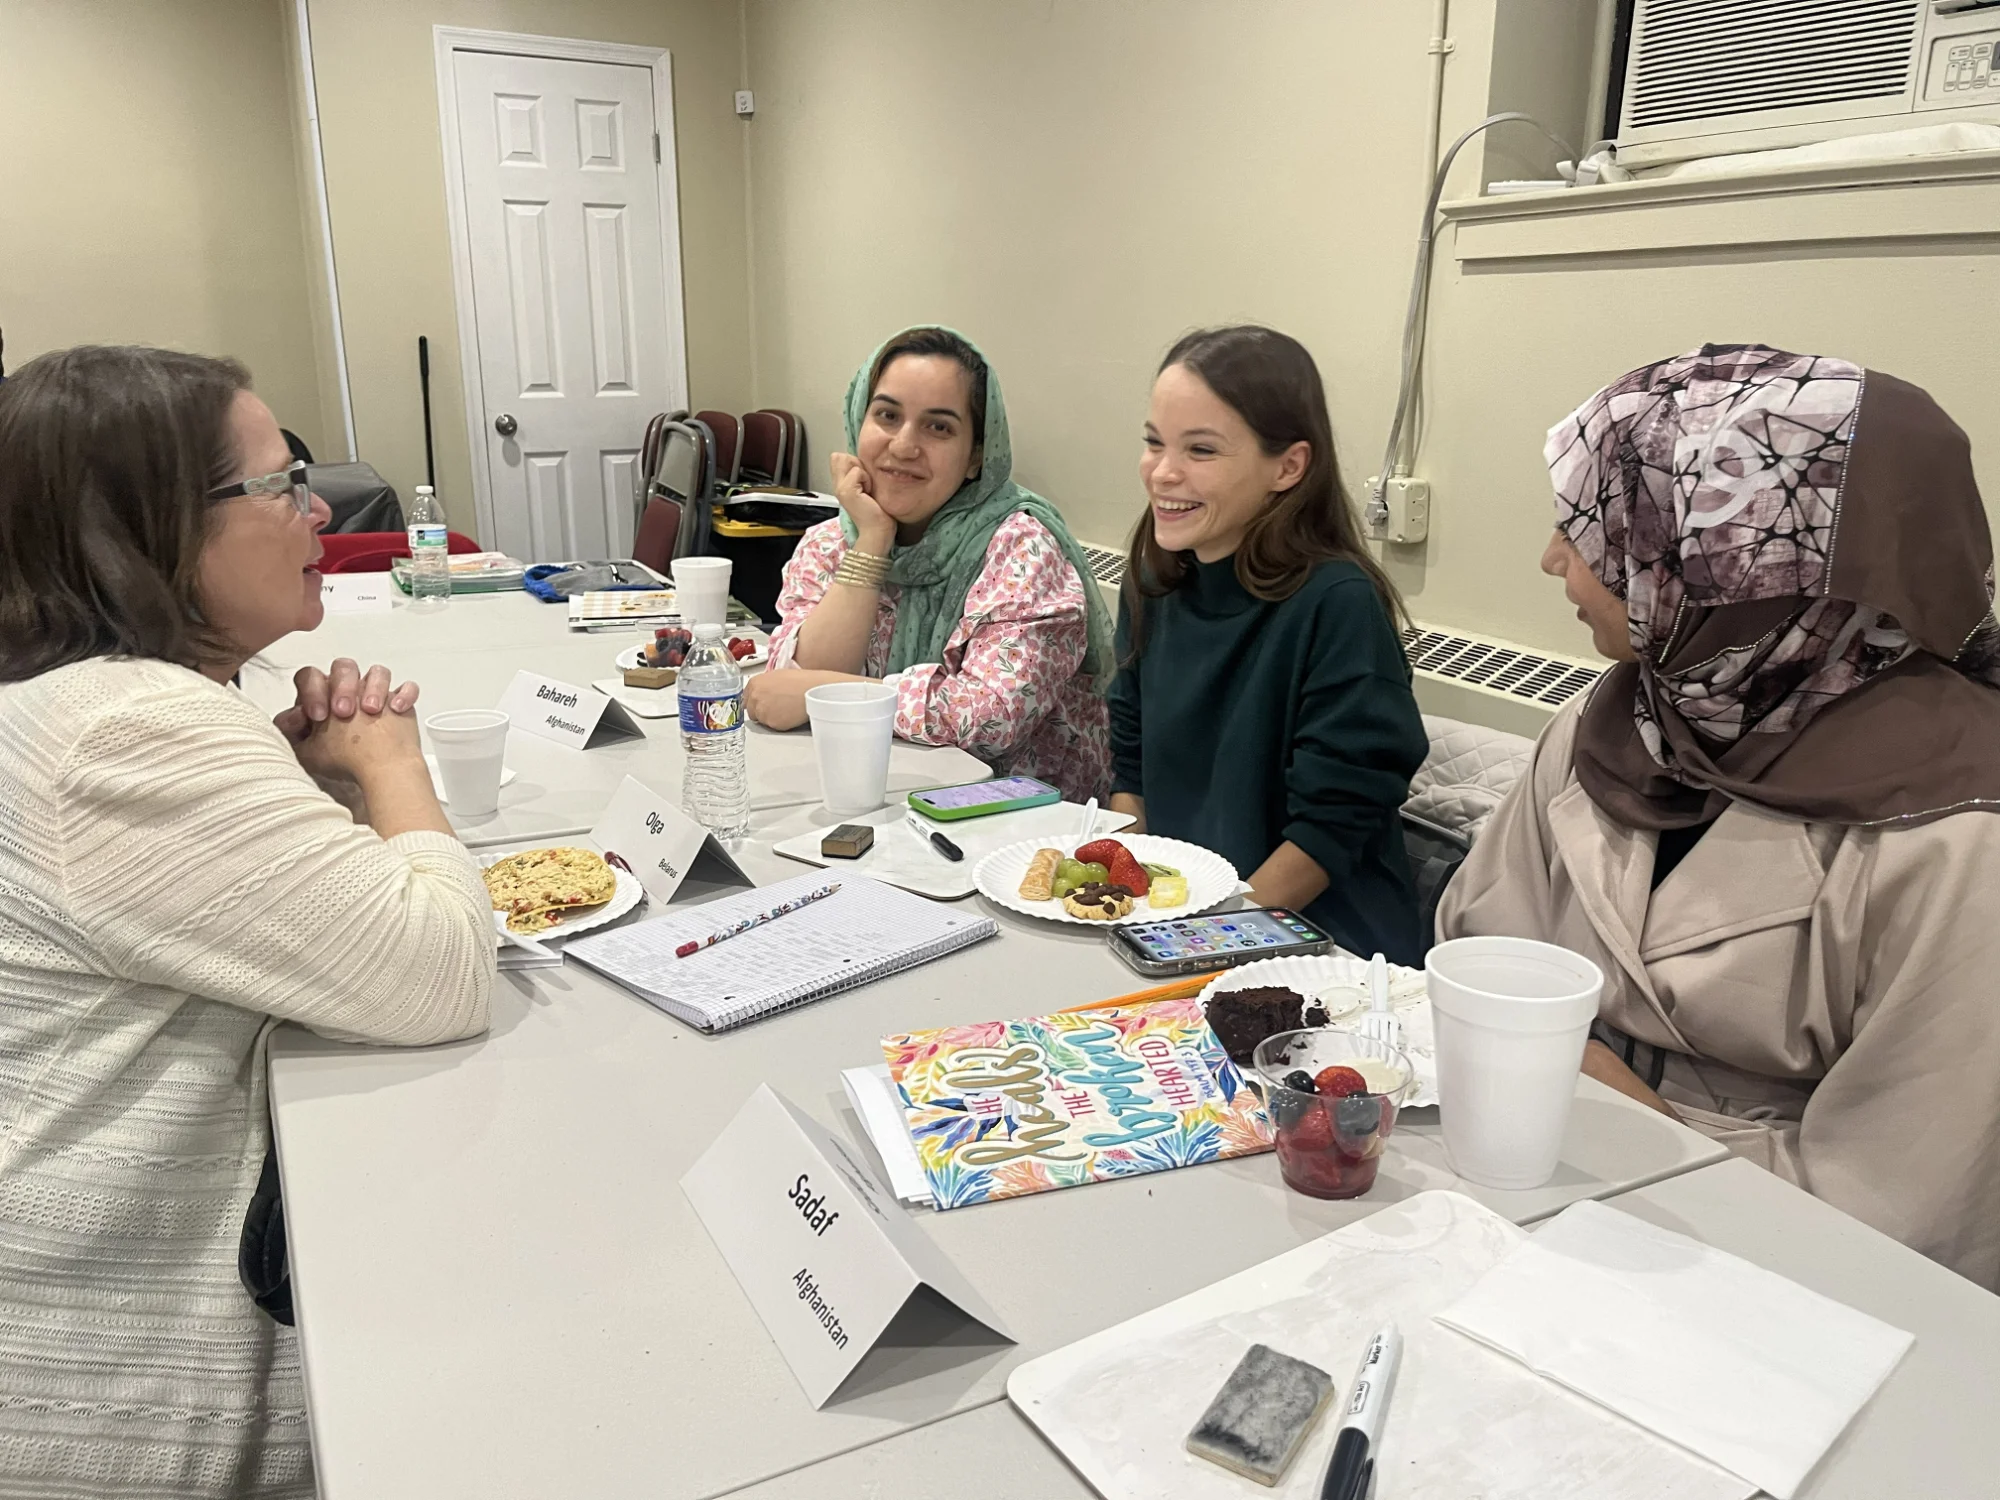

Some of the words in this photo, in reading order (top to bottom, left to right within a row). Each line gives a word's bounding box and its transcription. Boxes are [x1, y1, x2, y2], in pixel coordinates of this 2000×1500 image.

[536, 684, 578, 708] Bahareh
[545, 715, 585, 735] Afghanistan
[645, 811, 665, 834] Olga
[658, 858, 678, 878] Belarus
[1063, 1025, 1178, 1147] broken
[1138, 1040, 1197, 1106] HEARTED
[1194, 1073, 1217, 1098] PSALM
[945, 1048, 1088, 1165] heals
[971, 1095, 1003, 1115] HE
[1060, 1090, 1096, 1118] THE
[788, 1173, 839, 1237] Sadaf
[792, 1267, 849, 1350] Afghanistan
